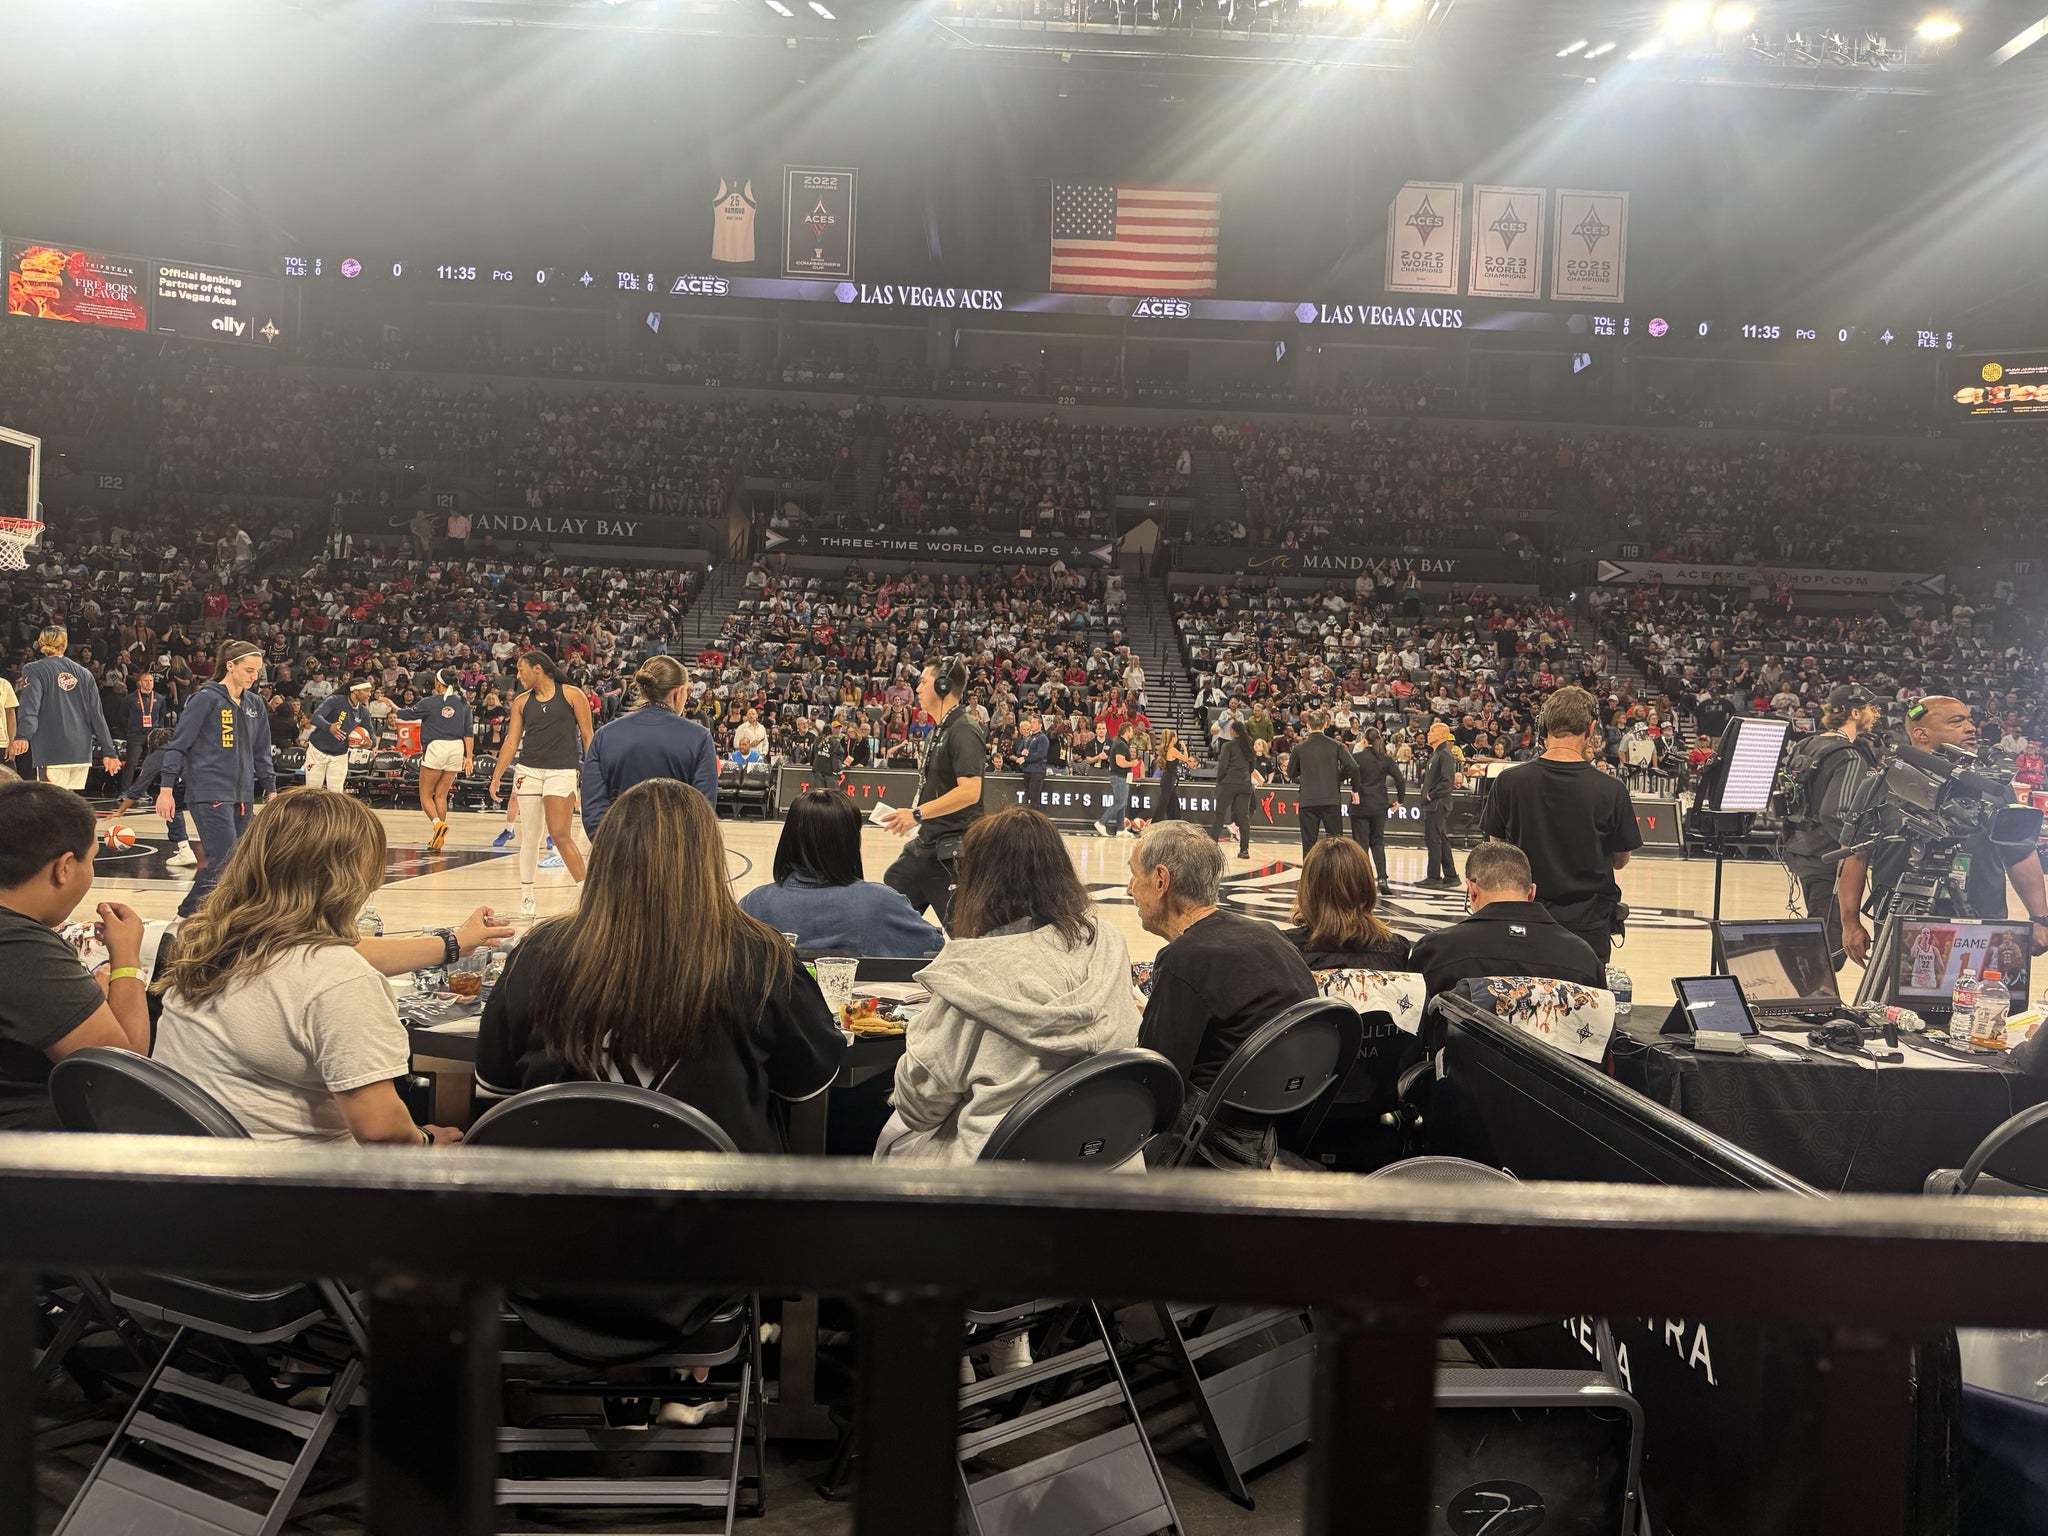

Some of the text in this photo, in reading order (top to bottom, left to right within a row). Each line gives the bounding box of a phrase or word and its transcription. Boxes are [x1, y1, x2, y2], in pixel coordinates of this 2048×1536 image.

[804, 176, 838, 186] 2022
[730, 195, 740, 206] 25
[804, 215, 835, 224] ACES
[1408, 217, 1442, 227] ACES
[1492, 222, 1527, 232] ACES
[1573, 226, 1608, 236] ACES
[1401, 250, 1444, 261] 2022
[1484, 256, 1527, 267] 2023
[284, 257, 321, 267] TOL: 5
[1402, 260, 1444, 269] WORLD
[1567, 260, 1610, 270] 2025
[286, 267, 321, 276] FLS: 0
[392, 264, 401, 276] 0
[436, 265, 513, 281] 11:35 PrG
[1485, 266, 1527, 274] WORLD
[1568, 269, 1610, 278] WORLD
[159, 267, 242, 288] Official Banking
[536, 270, 546, 283] 0
[617, 272, 654, 282] TOL: 5
[75, 278, 137, 295] FIRE-BORN
[159, 277, 232, 295] Partner of the
[618, 280, 654, 291] FLS: 0
[674, 279, 727, 294] ACES
[84, 287, 128, 301] FLAVOR
[159, 287, 237, 306] Las Vegas Aces
[860, 284, 1003, 311] LAS VEGAS ACES
[1137, 303, 1188, 317] ACES
[1320, 304, 1463, 329] LAS VEGAS ACES
[1594, 317, 1630, 327] TOL: 5
[211, 316, 246, 336] ally
[1594, 326, 1630, 335] FLS: 0
[1698, 323, 1708, 336] 0
[1742, 324, 1816, 340] 11:35 PrG
[1838, 329, 1847, 342] 0
[1917, 331, 1953, 341] TOL: 5
[1918, 339, 1952, 350] FLS: 0
[372, 361, 392, 370] 222
[704, 378, 721, 387] 221
[1057, 396, 1076, 405] 220
[99, 475, 123, 489] 122
[436, 494, 453, 507] 121
[596, 520, 635, 537] BAY
[820, 537, 1059, 556] THREE-TIME WORLD CHAMPS
[1622, 545, 1639, 558] 118
[1303, 555, 1456, 573] MANDAAY BAY
[2015, 562, 2031, 575] 117
[1677, 570, 1868, 585] ACETEHOP.COM
[336, 710, 347, 729] VER
[221, 709, 234, 748] FEVER
[400, 728, 409, 739] G
[1017, 791, 1091, 807] TERE'S
[1102, 795, 1150, 808] MRE
[2018, 793, 2028, 804] G
[1953, 938, 1988, 949] GAME
[1959, 952, 1970, 978] 1
